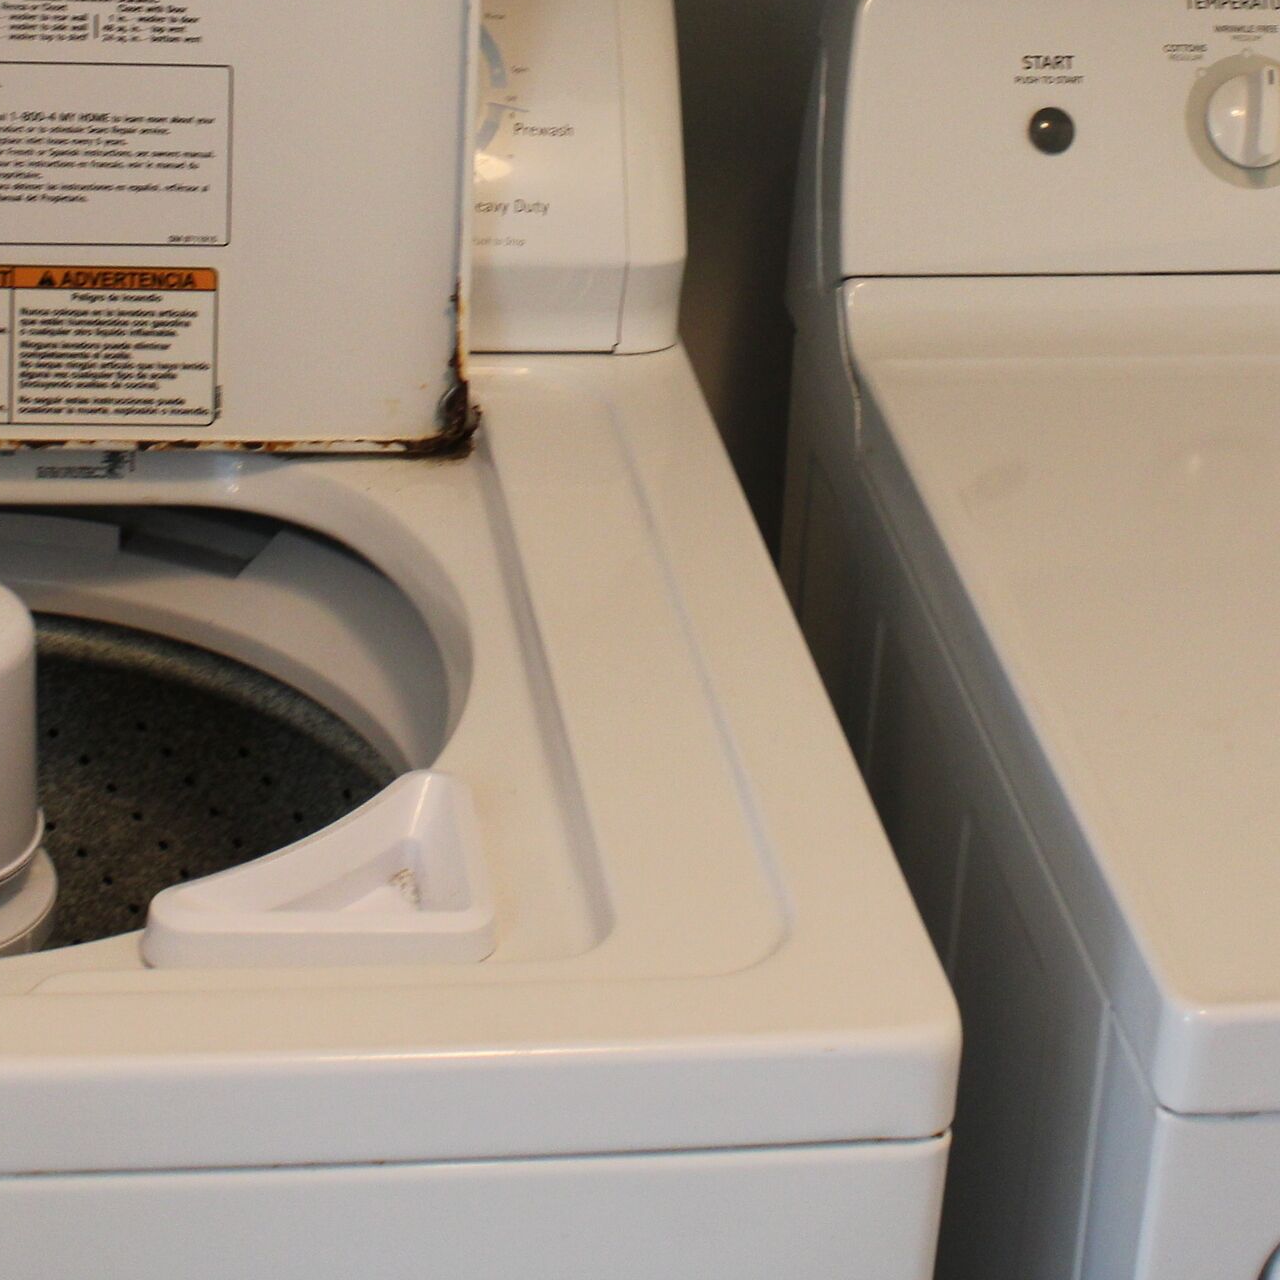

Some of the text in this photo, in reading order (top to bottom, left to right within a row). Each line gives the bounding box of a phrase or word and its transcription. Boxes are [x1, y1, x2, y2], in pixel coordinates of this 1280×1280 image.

[1023, 56, 1073, 70] START
[512, 122, 576, 137] Prewash
[474, 198, 550, 217] eavy Duty
[61, 270, 197, 288] ADVERTENCIA
